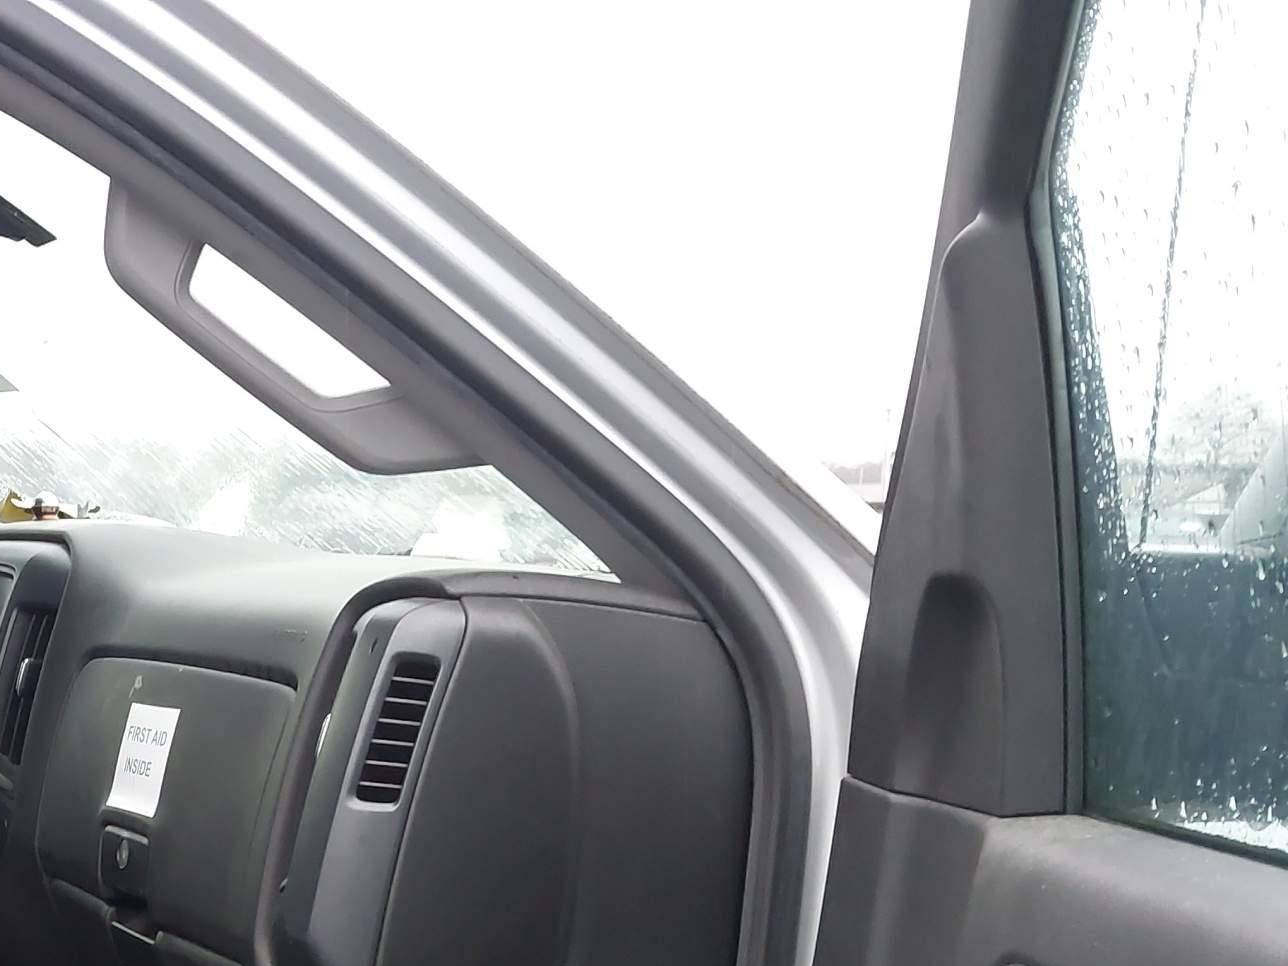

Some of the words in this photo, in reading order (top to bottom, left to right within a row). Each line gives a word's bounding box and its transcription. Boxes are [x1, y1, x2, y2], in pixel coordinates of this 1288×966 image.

[127, 725, 151, 743] FIRST
[152, 729, 168, 746] AID
[124, 757, 152, 777] INSIDE
